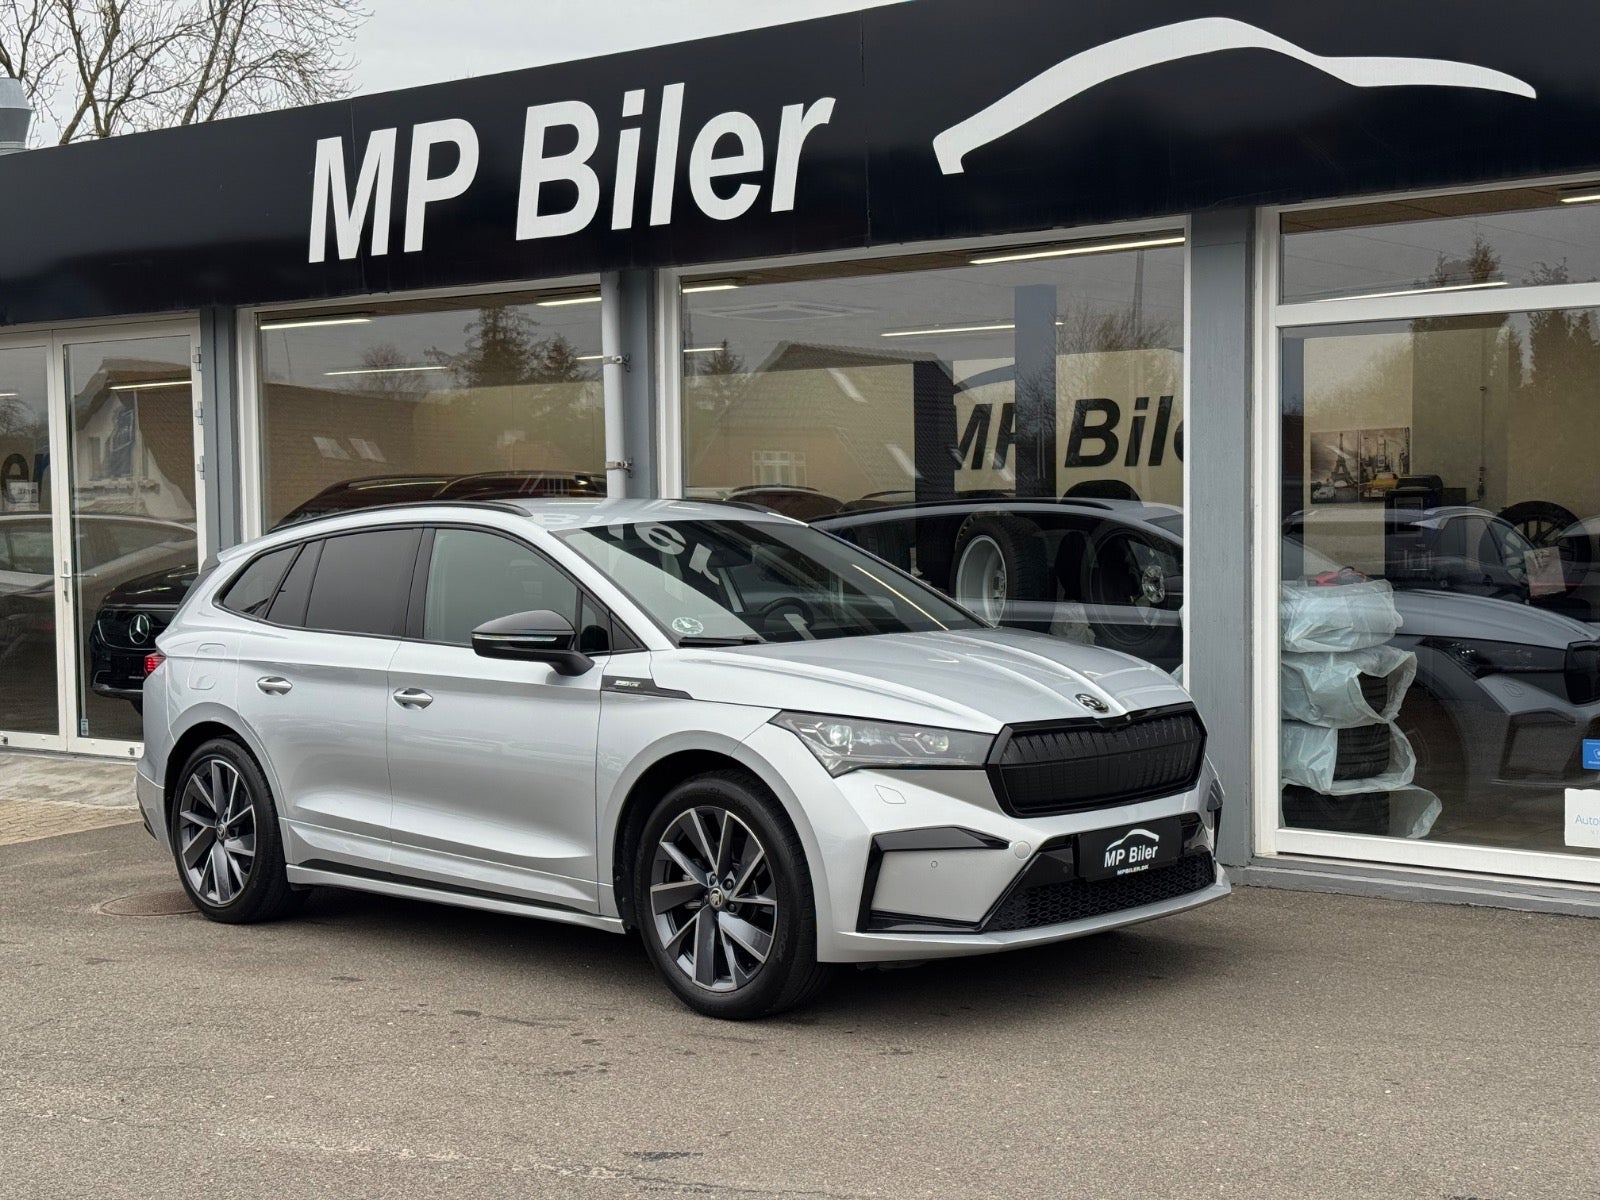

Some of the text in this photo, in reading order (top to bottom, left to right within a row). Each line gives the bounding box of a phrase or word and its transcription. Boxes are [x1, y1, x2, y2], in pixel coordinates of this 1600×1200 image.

[308, 82, 837, 263] MP Biler
[1575, 814, 1600, 826] Auto
[1104, 844, 1159, 868] MP Biler
[1116, 864, 1149, 876] MPBILER.DK
